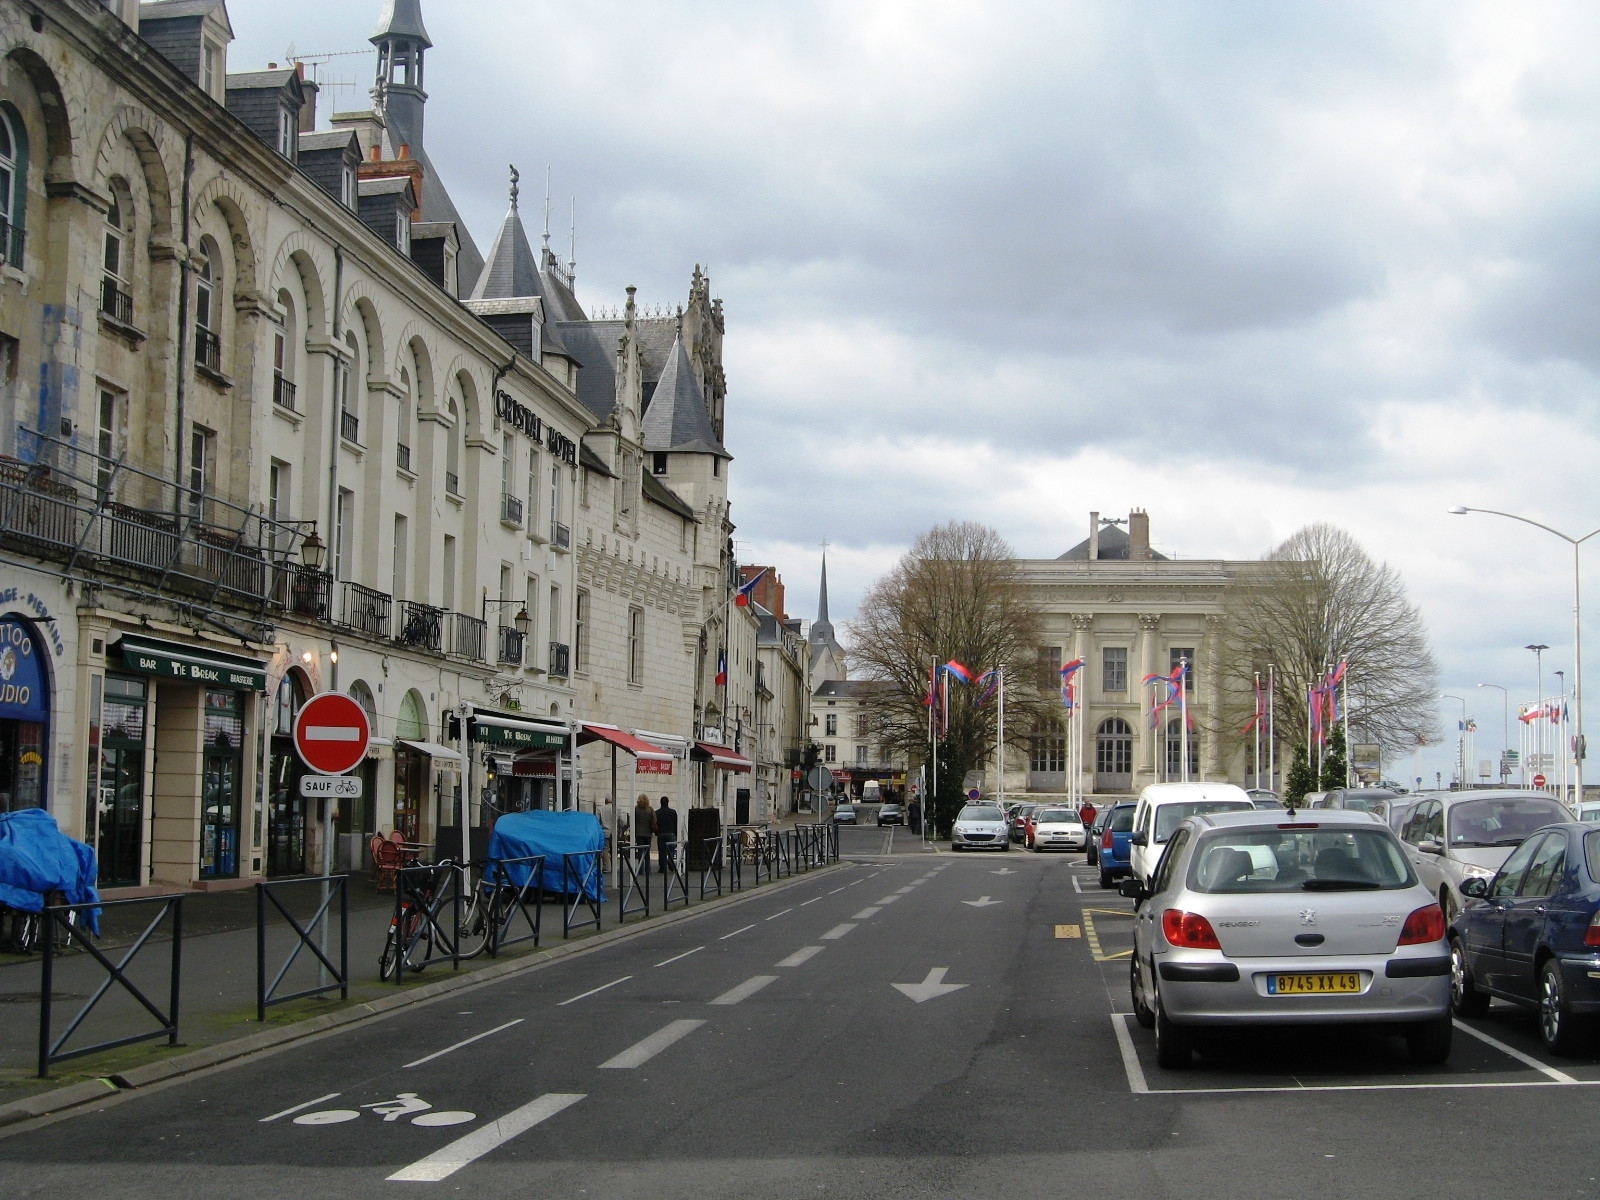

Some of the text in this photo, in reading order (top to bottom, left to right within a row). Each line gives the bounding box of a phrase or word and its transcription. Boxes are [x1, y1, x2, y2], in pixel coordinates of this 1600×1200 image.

[27, 593, 64, 656] PIERING
[140, 657, 157, 670] BAR
[305, 782, 332, 791] SAUF
[1278, 976, 1313, 991] 8745
[1318, 976, 1335, 990] XX
[1340, 976, 1356, 990] 49
